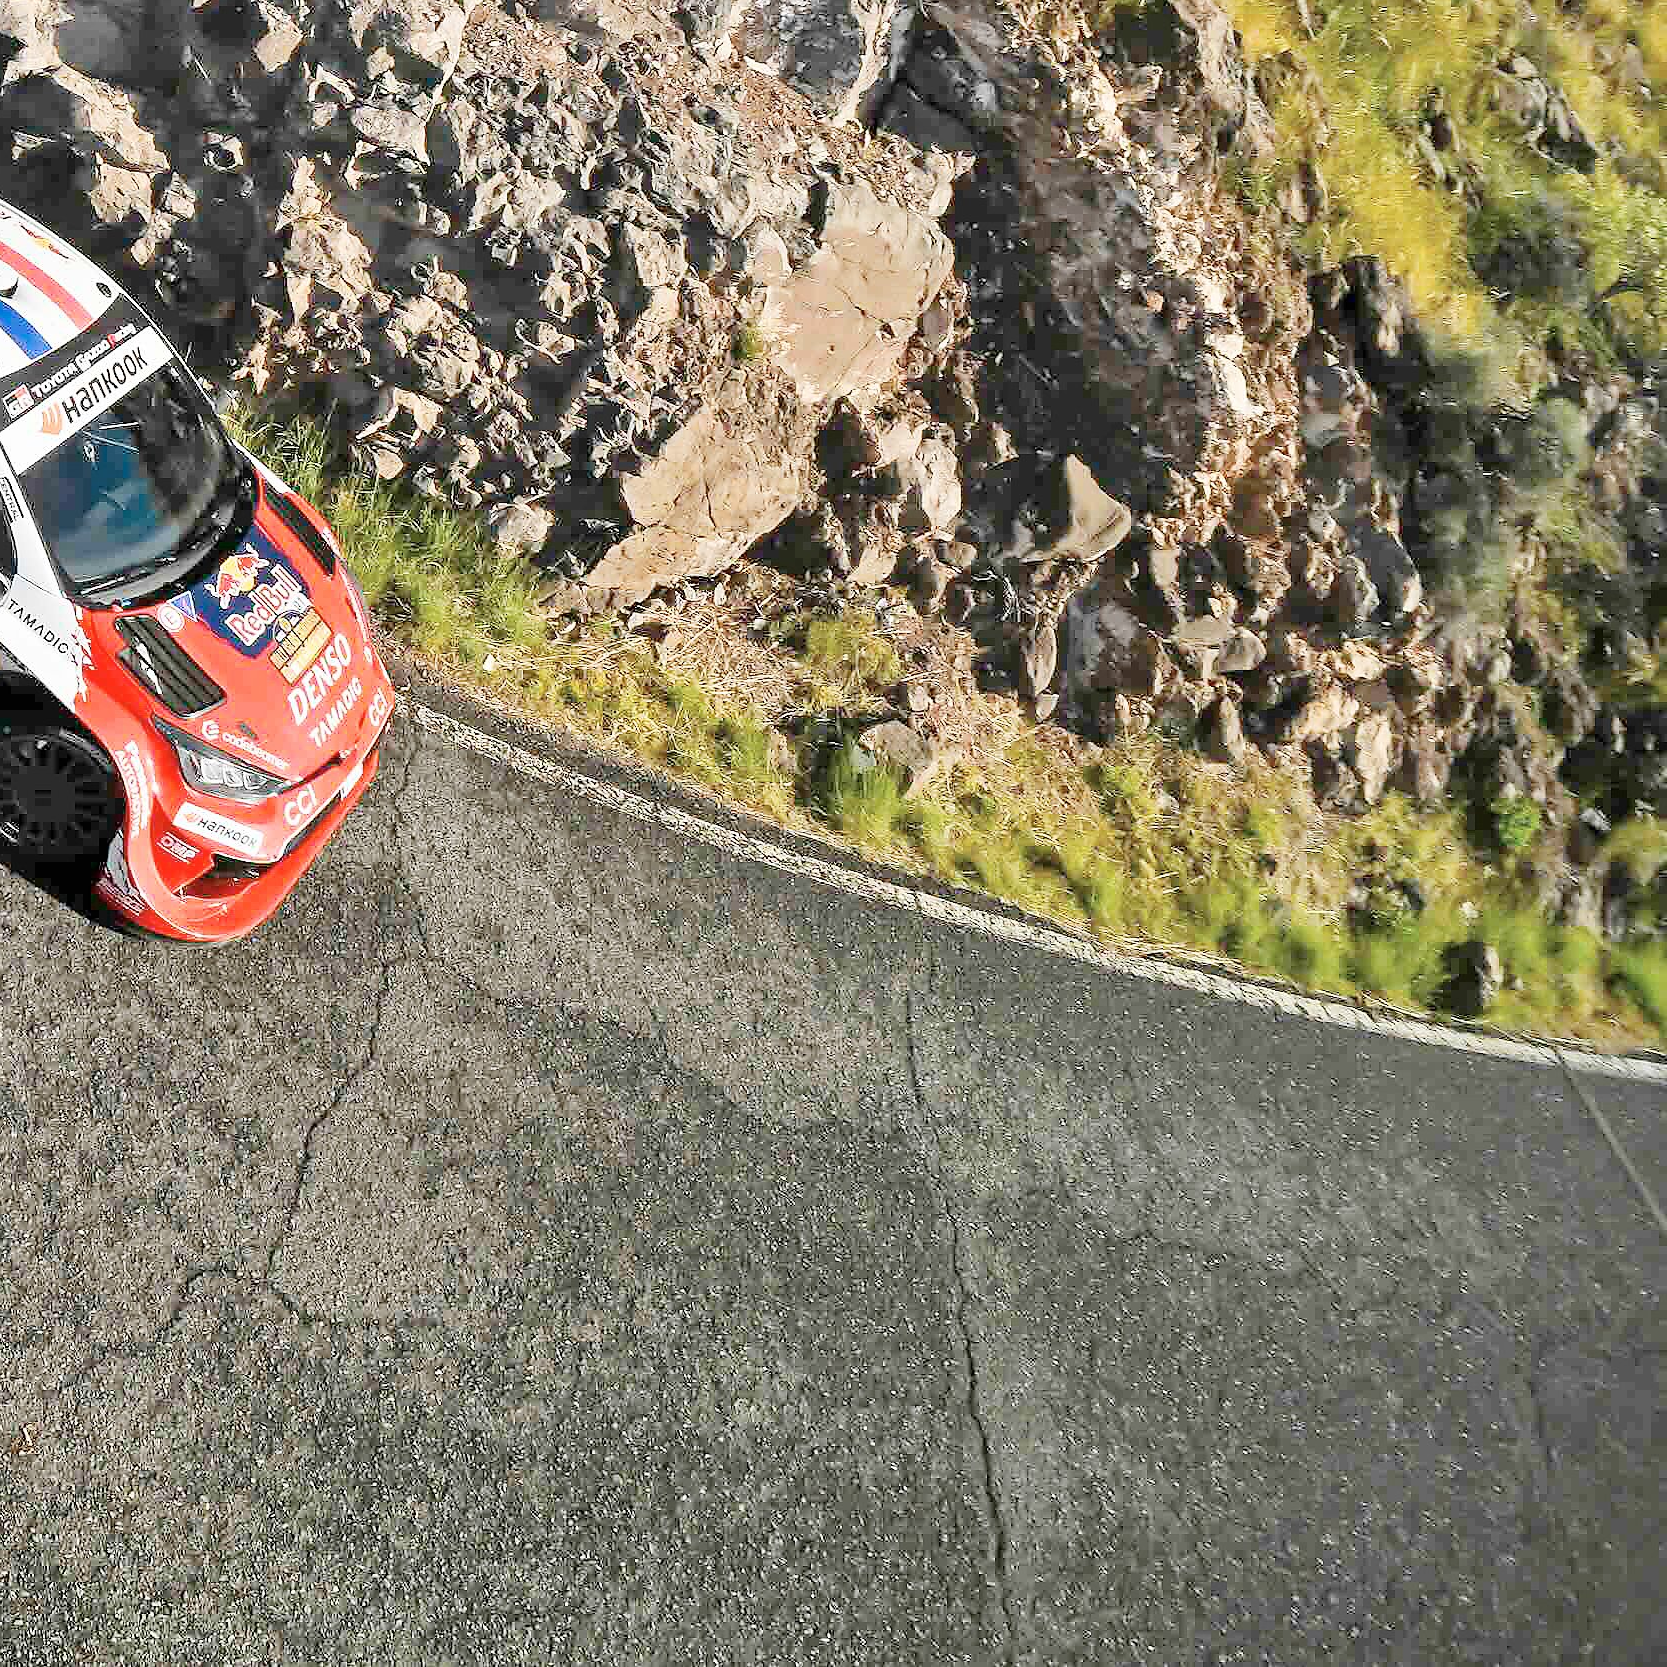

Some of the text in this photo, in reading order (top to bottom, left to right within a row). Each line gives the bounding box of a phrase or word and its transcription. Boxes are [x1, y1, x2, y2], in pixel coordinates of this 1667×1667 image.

[31, 365, 79, 399] TOYOTA
[8, 598, 69, 654] TAMADIC
[288, 633, 352, 726] DENSO
[310, 677, 363, 747] TAMADIC
[368, 687, 389, 726] CCI
[285, 785, 317, 826] CCI
